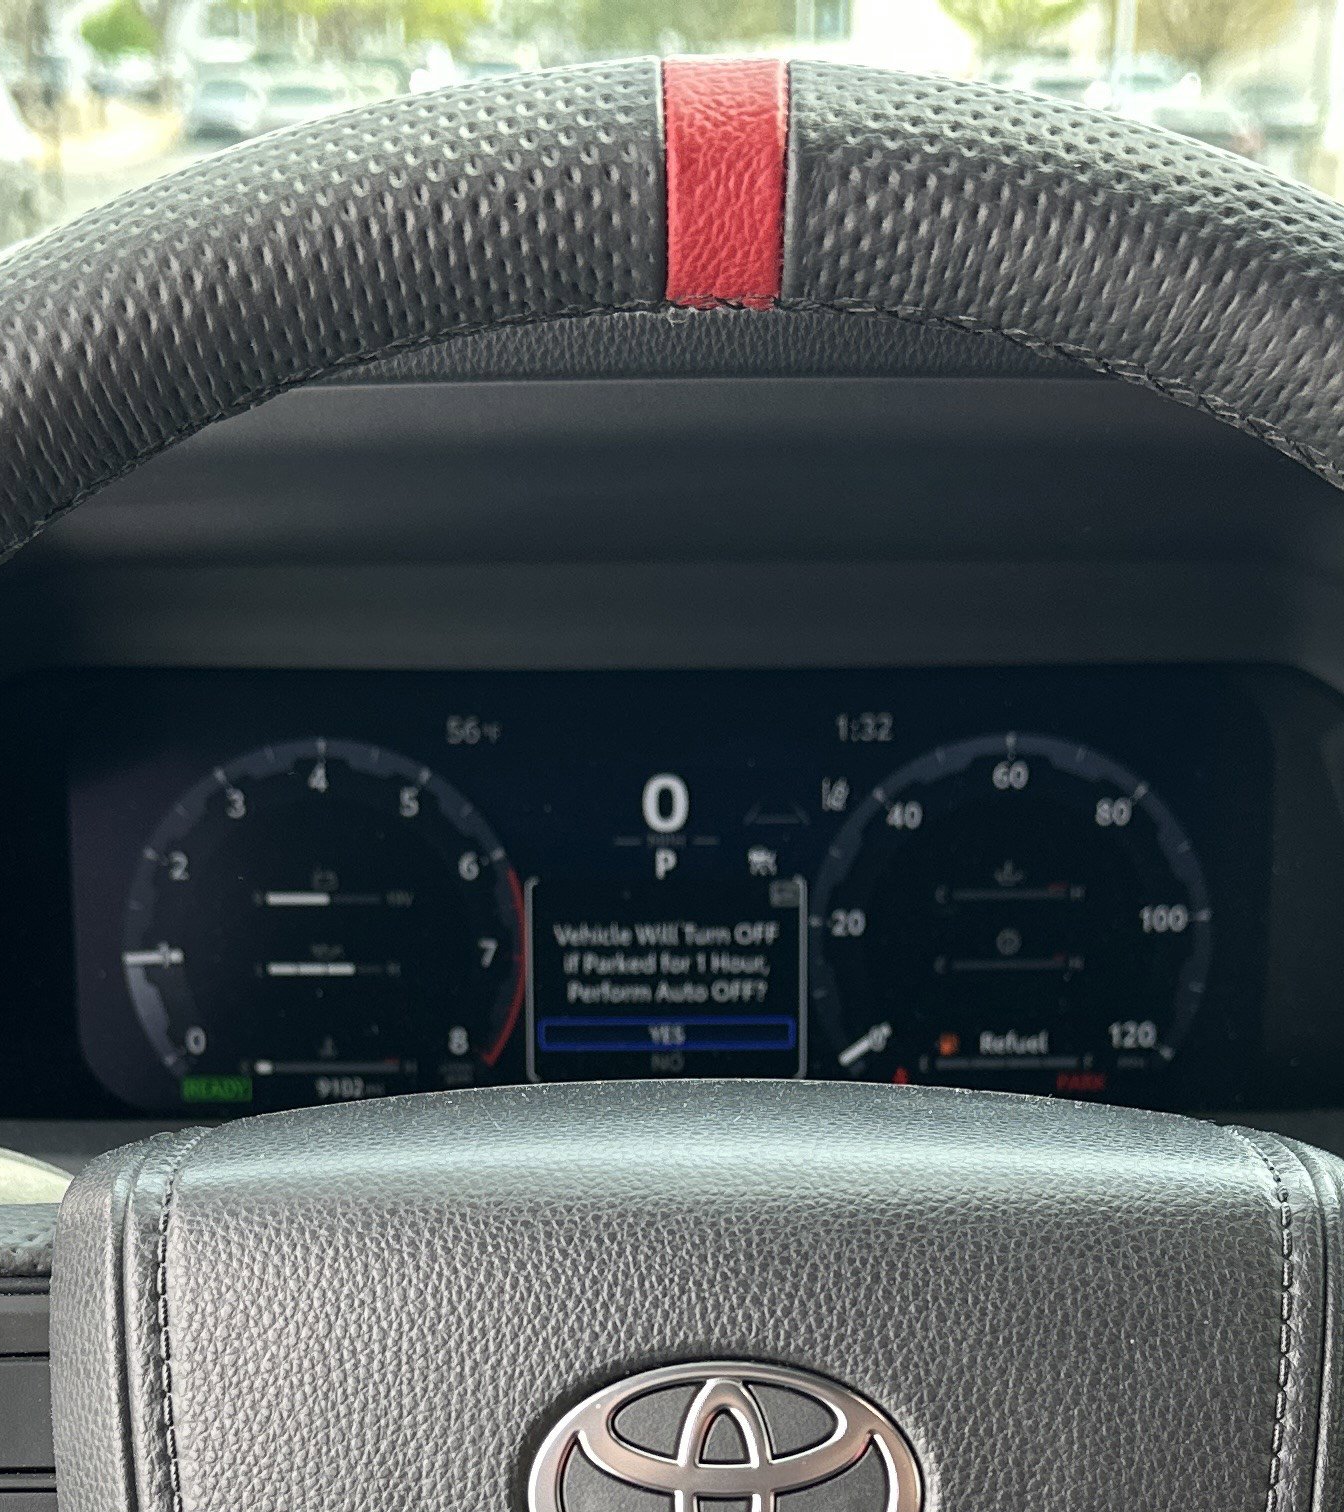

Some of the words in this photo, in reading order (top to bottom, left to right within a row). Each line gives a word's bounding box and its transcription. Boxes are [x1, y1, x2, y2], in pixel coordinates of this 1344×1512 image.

[835, 713, 894, 742] 1:32
[308, 763, 330, 793] 4
[992, 761, 1030, 791] 60
[225, 788, 247, 820] 3
[399, 786, 420, 818] 5
[641, 772, 691, 834] 0
[886, 801, 924, 830] 40
[1095, 797, 1133, 828] 80
[168, 851, 190, 882] 2
[458, 851, 481, 881] 6
[654, 847, 679, 881] P
[553, 921, 633, 947] Vehicle
[634, 921, 680, 946] Will
[682, 923, 732, 946] Turn
[733, 920, 781, 945] OFF
[830, 908, 867, 938] 20
[1138, 904, 1190, 934] 100
[477, 938, 498, 969] 7
[583, 952, 658, 975] Parked
[659, 952, 691, 975] for
[566, 980, 653, 1005] Perform
[655, 979, 709, 1004] Auto
[710, 978, 769, 1004] OFF?
[185, 1025, 207, 1056] 0
[447, 1025, 470, 1057] 8
[648, 1023, 687, 1045] YES
[978, 1030, 1050, 1056] Refuel
[1108, 1020, 1157, 1050] 120
